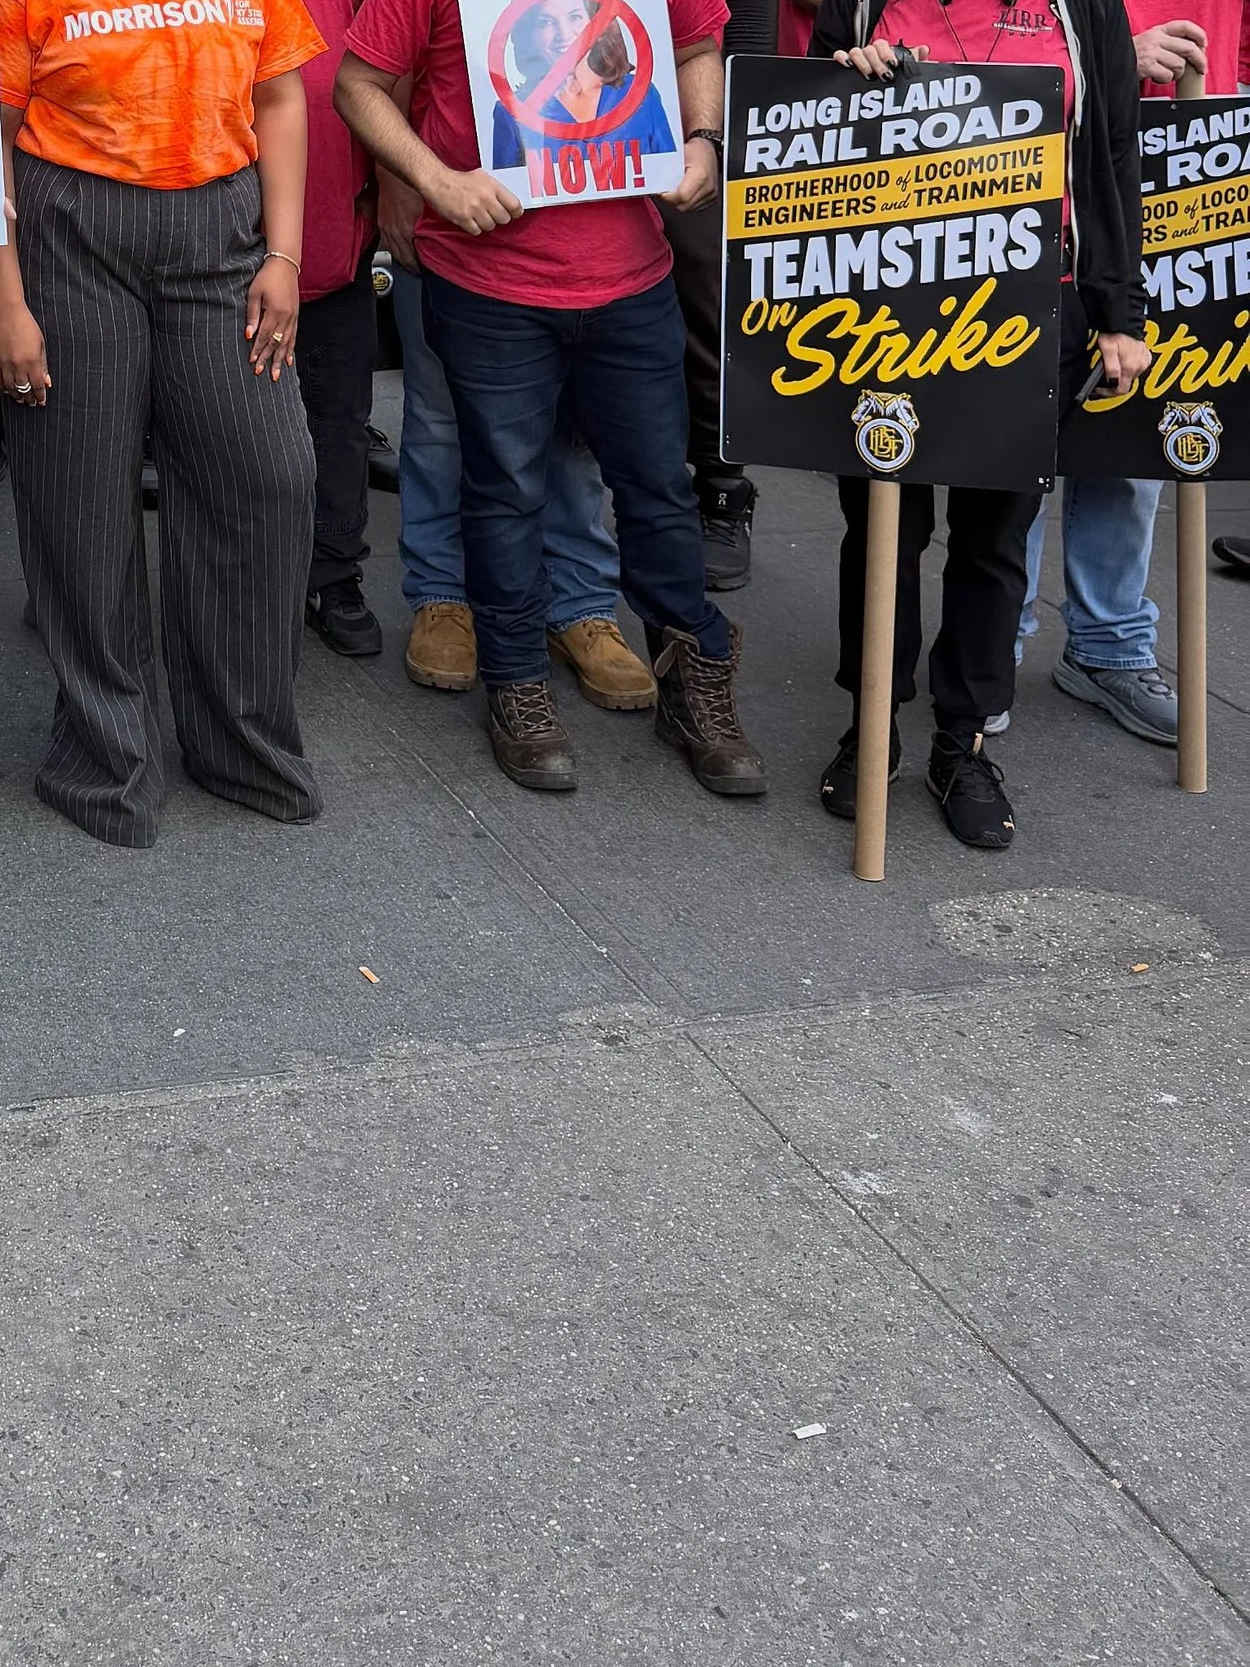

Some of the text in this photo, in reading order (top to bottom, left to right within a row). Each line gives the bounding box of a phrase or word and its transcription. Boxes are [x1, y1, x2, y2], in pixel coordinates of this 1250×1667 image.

[64, 0, 226, 41] MORRISON
[747, 75, 981, 136] LONG ISLAND
[745, 99, 1043, 173] RAIL ROAD
[525, 140, 646, 198] NOW!
[745, 146, 1044, 205] BROTHERHOOD of LOCOMOTIVE
[744, 171, 1042, 228] ENGINEERS and TRAINMEN
[1172, 218, 1200, 239] and
[1184, 197, 1198, 219] of
[744, 207, 1042, 301] TEAMSTERS
[741, 297, 797, 335] On
[771, 277, 1040, 396] Strike
